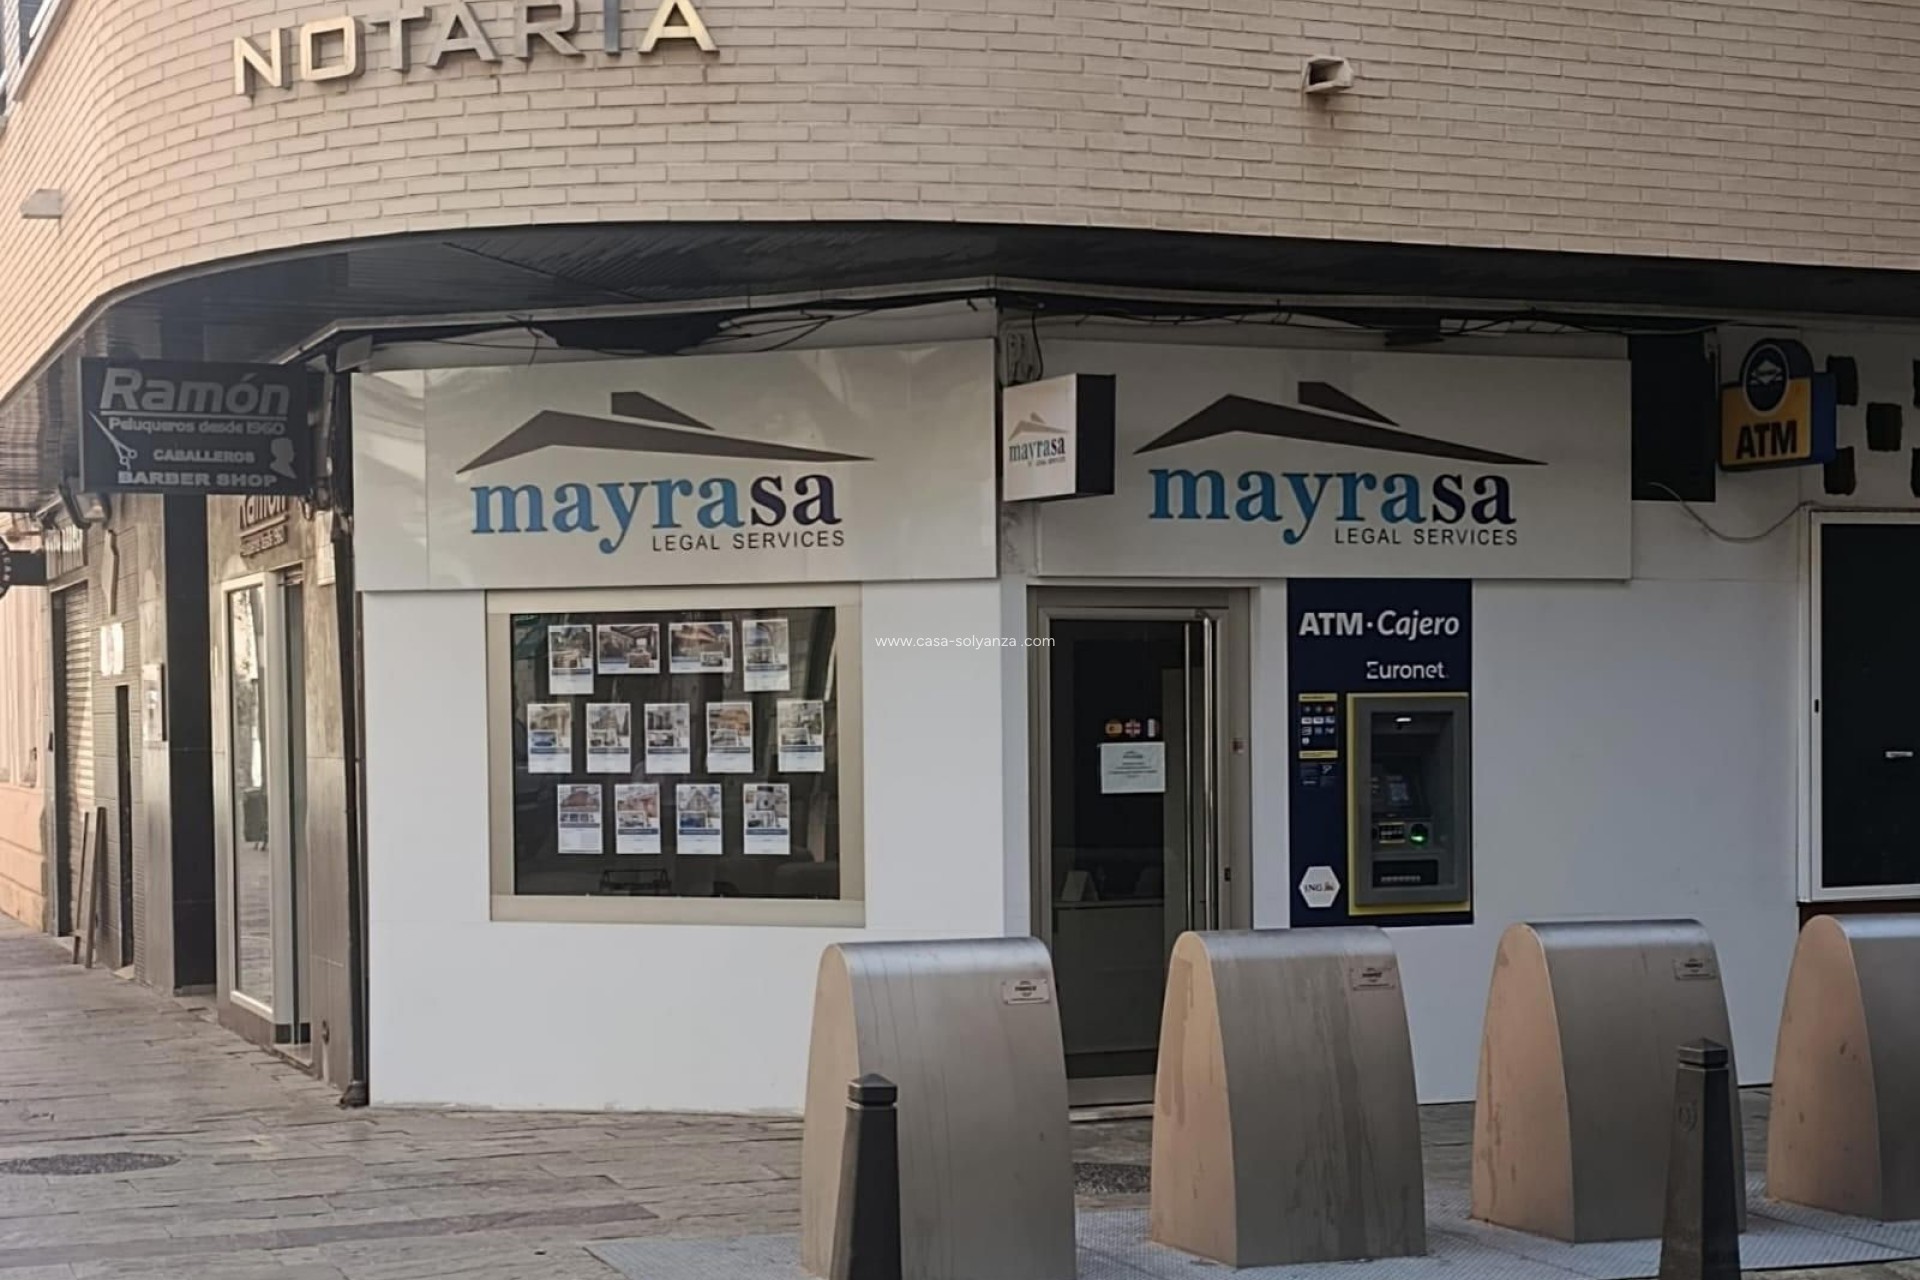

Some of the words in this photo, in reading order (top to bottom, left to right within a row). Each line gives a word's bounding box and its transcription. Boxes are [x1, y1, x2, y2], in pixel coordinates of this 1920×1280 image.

[233, 0, 721, 97] NOTARIA
[100, 367, 291, 415] Ramón
[109, 416, 195, 434] Peluqueros
[199, 420, 243, 434] desde
[246, 421, 286, 435] 1960
[1735, 419, 1798, 460] ATM
[153, 449, 256, 464] CABALLEROS
[1008, 436, 1067, 468] mayrasa
[118, 470, 212, 487] BARBER
[216, 473, 278, 488] SHOP
[470, 473, 843, 554] mayrasa
[1148, 468, 1518, 545] mayrasa
[652, 534, 720, 552] LEGAL
[732, 530, 845, 550] SERVICES
[1334, 527, 1402, 545] LEGAL
[1413, 528, 1518, 546] SERVICES
[1366, 661, 1447, 680] Euronet
[1304, 883, 1323, 892] ING
